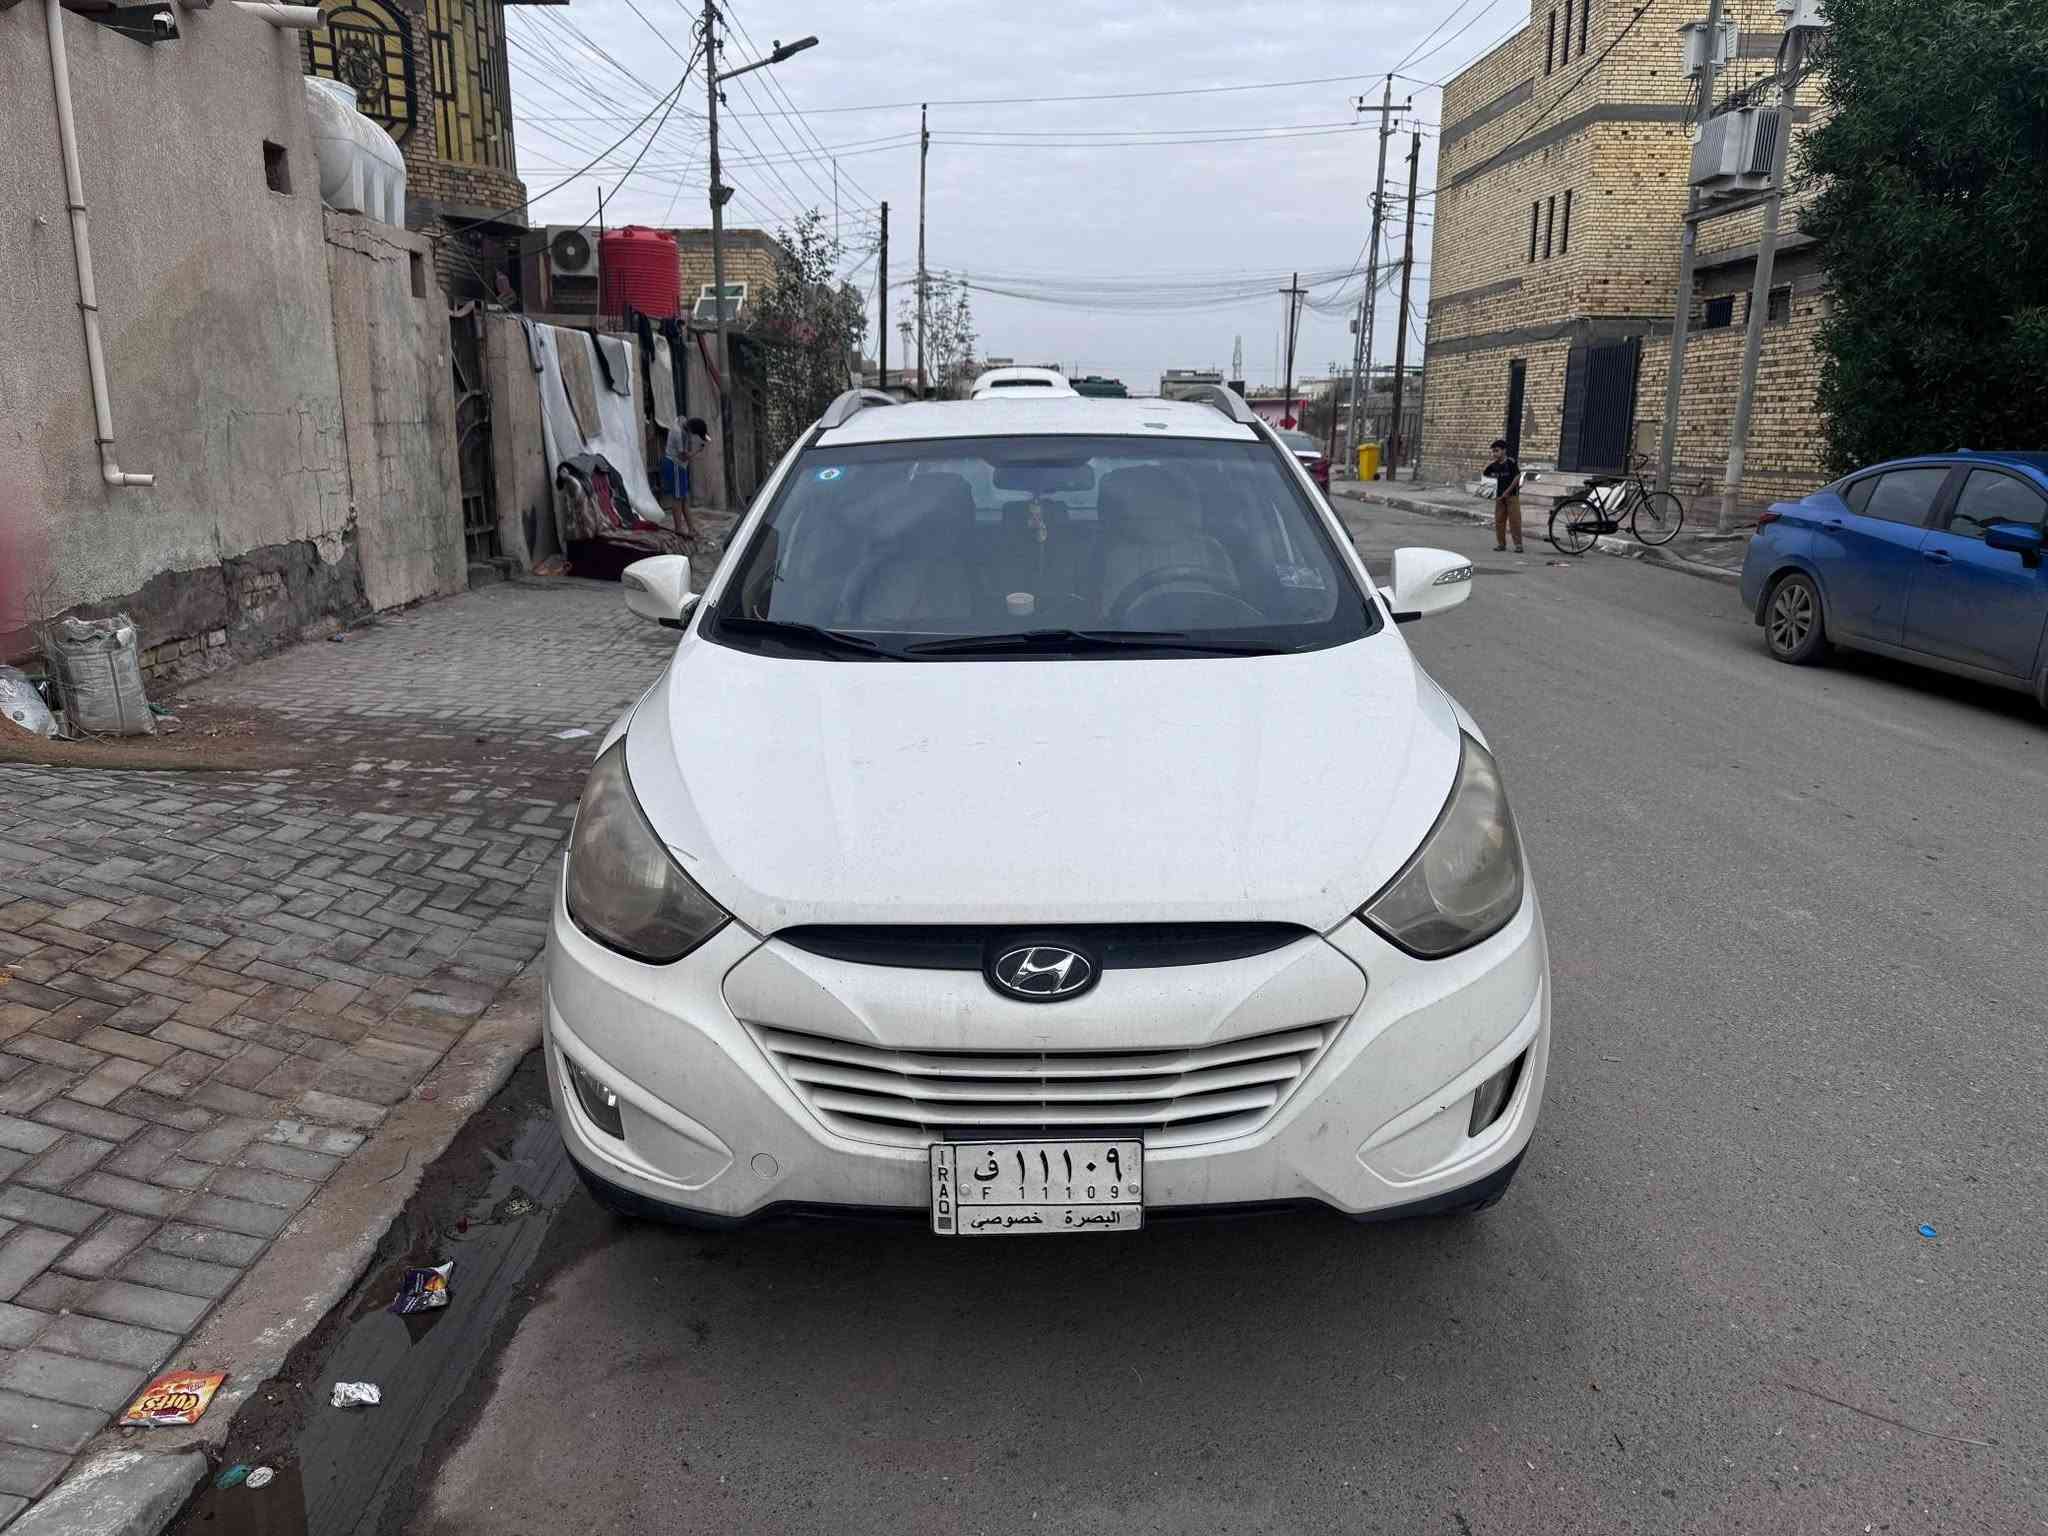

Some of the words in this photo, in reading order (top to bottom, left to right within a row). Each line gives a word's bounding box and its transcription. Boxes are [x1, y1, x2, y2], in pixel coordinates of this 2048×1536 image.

[974, 1150, 999, 1181] ف
[937, 1151, 950, 1215] IRAQ
[982, 1186, 992, 1200] F
[1018, 1185, 1119, 1200] 11109
[971, 1210, 1043, 1229] خصوصي
[1065, 1210, 1120, 1228] البصرة
